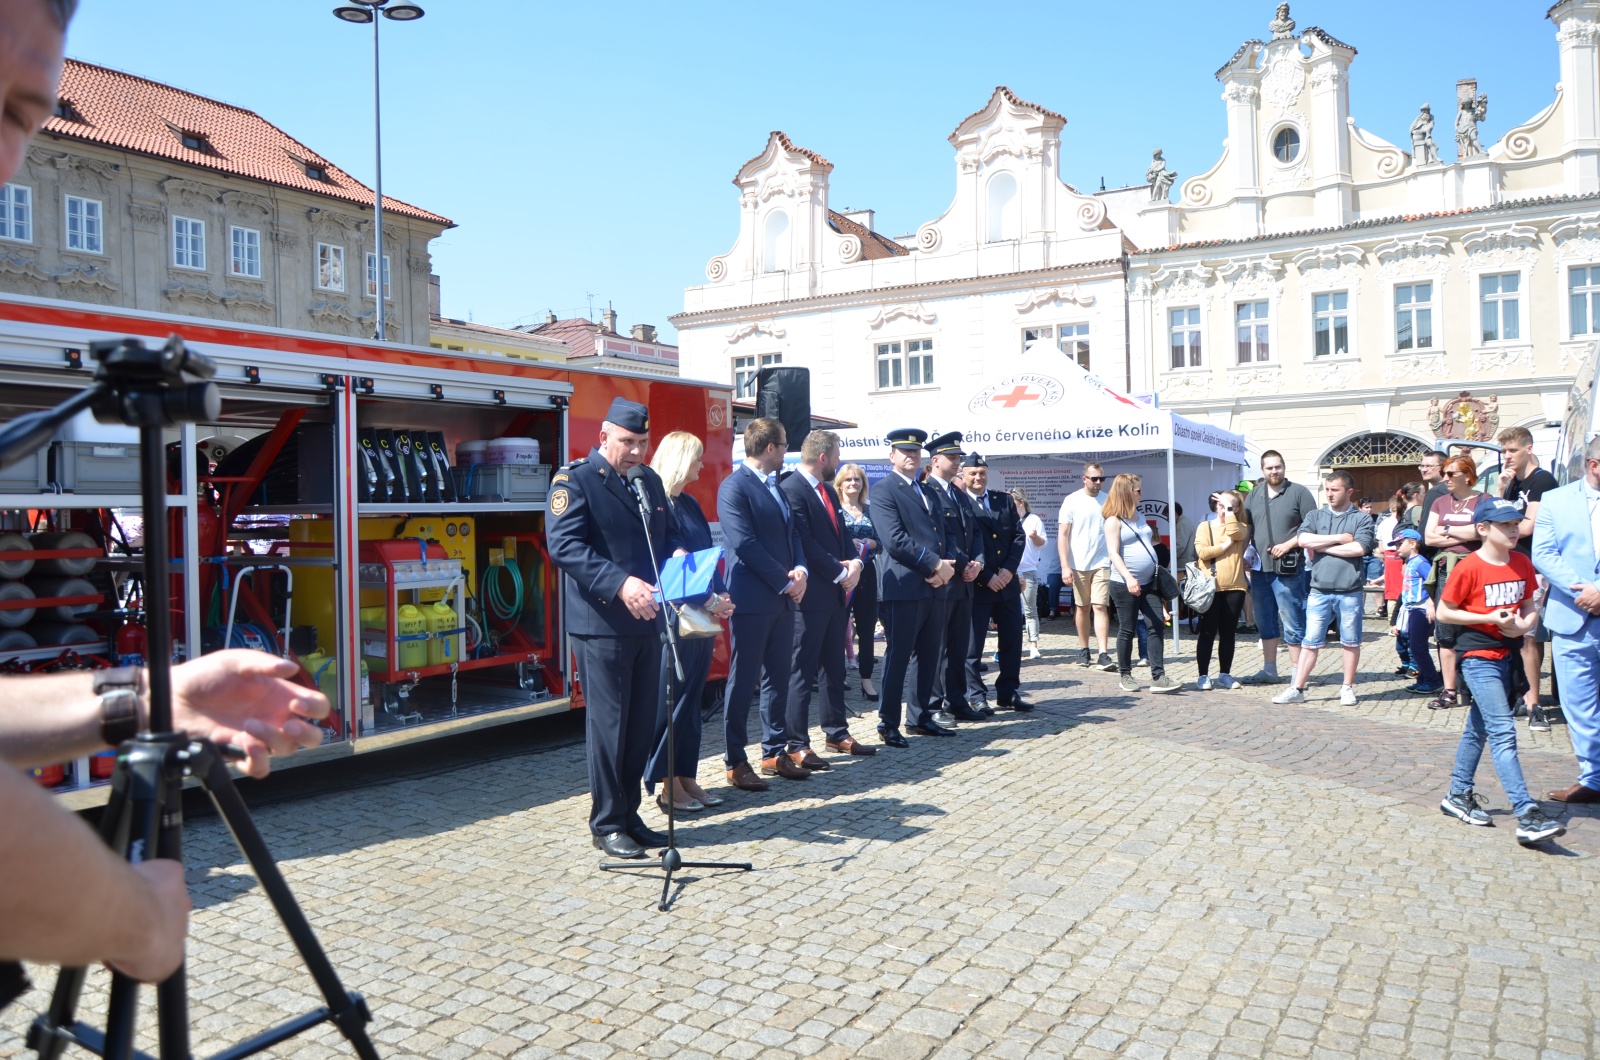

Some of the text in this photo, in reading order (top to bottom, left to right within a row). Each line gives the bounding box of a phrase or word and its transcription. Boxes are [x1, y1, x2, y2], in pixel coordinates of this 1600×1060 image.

[995, 428, 1072, 442] červeného
[1076, 426, 1114, 439] kříže
[1119, 422, 1160, 436] Kolín
[1333, 456, 1342, 465] U
